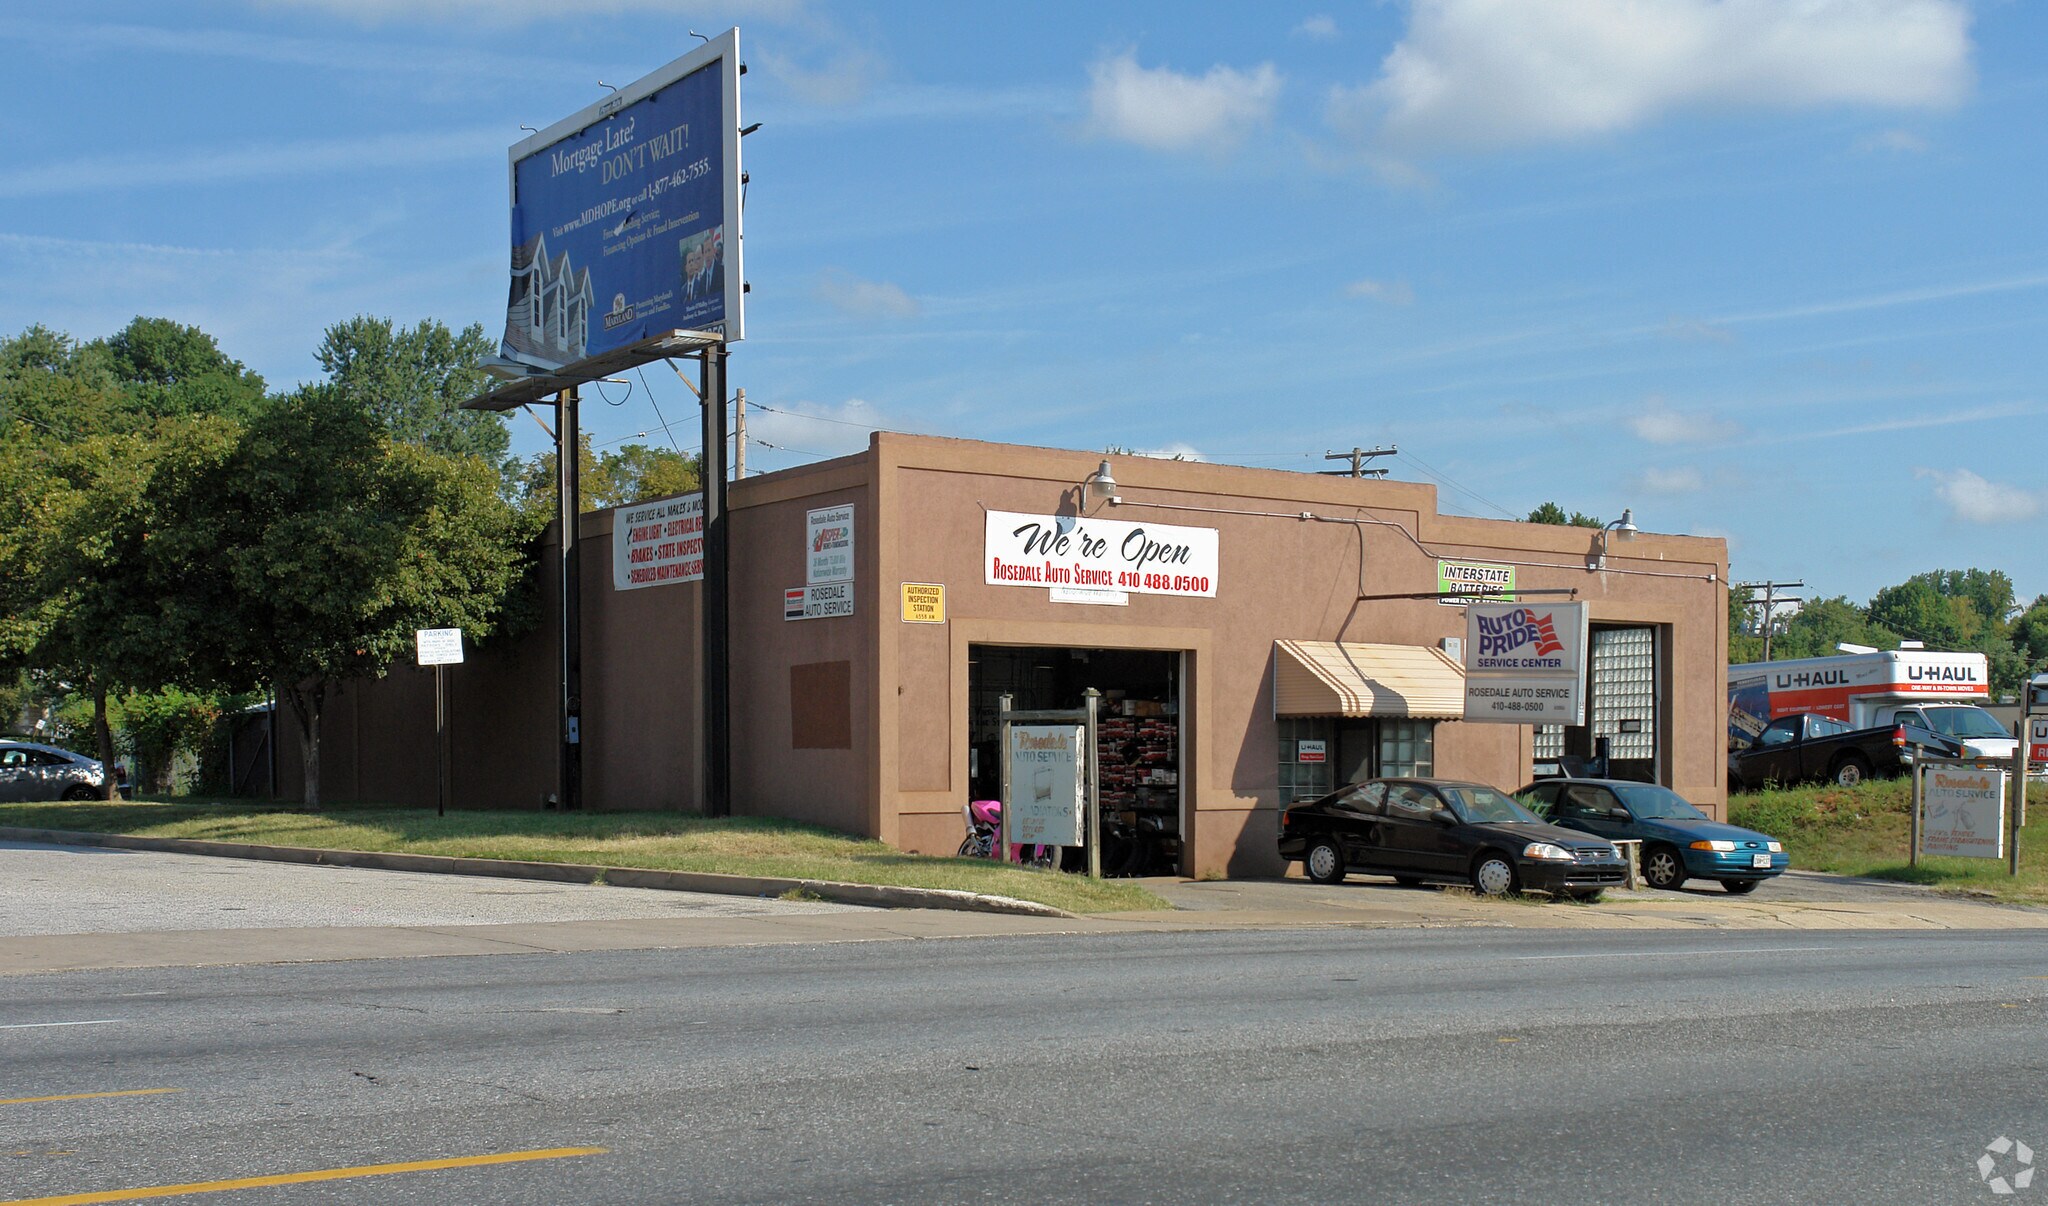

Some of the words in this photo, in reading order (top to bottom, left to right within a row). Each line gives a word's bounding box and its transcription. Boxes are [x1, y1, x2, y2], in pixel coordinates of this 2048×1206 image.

[552, 140, 603, 178] Mortgage
[605, 116, 635, 152] Late?
[602, 142, 646, 185] DON'T
[648, 123, 689, 163] WAIT!
[563, 197, 631, 233] www.MDHOPE.org
[625, 512, 634, 524] WE
[635, 508, 655, 523] SERVICE
[656, 506, 666, 519] ALL
[667, 501, 686, 517] MAKES
[811, 515, 827, 525] Rosedale
[827, 513, 836, 522] Auto
[836, 511, 850, 521] Service
[632, 525, 648, 543] ENGINE
[648, 523, 662, 540] LIGHT
[667, 517, 694, 537] ELECTRICAL
[631, 546, 654, 564] BRAKES
[657, 542, 676, 560] STATE
[1013, 521, 1108, 558] We're
[1121, 527, 1192, 571] Open
[630, 566, 656, 584] SCHEDULED
[656, 560, 691, 580] MAINTENANCE
[993, 556, 1042, 582] ROSEDALE
[1045, 560, 1071, 584] AUTO
[1074, 562, 1113, 586] SERVICE
[1118, 570, 1140, 588] 410
[1144, 573, 1209, 592] 488.0500
[1444, 566, 1510, 582] INTERSTATE
[811, 586, 845, 601] ROSEDALE
[907, 586, 940, 596] AUTHORIZED
[908, 595, 939, 604] INSPECTION
[805, 603, 821, 617] AUTO
[824, 600, 852, 615] SERVICE
[913, 604, 934, 612] STATION
[1476, 608, 1526, 635] AUTO
[1478, 623, 1541, 656] PRIDE
[1477, 658, 1519, 668] SERVICE
[1521, 658, 1562, 668] CENTER
[1776, 669, 1850, 688] U-HAUL
[1908, 665, 1977, 682] U-HAUL
[1468, 687, 1510, 698] ROSEDALE
[1512, 688, 1534, 698] AUTO
[1535, 688, 1570, 699] SERVICE
[1491, 701, 1544, 712] 410-488-0500
